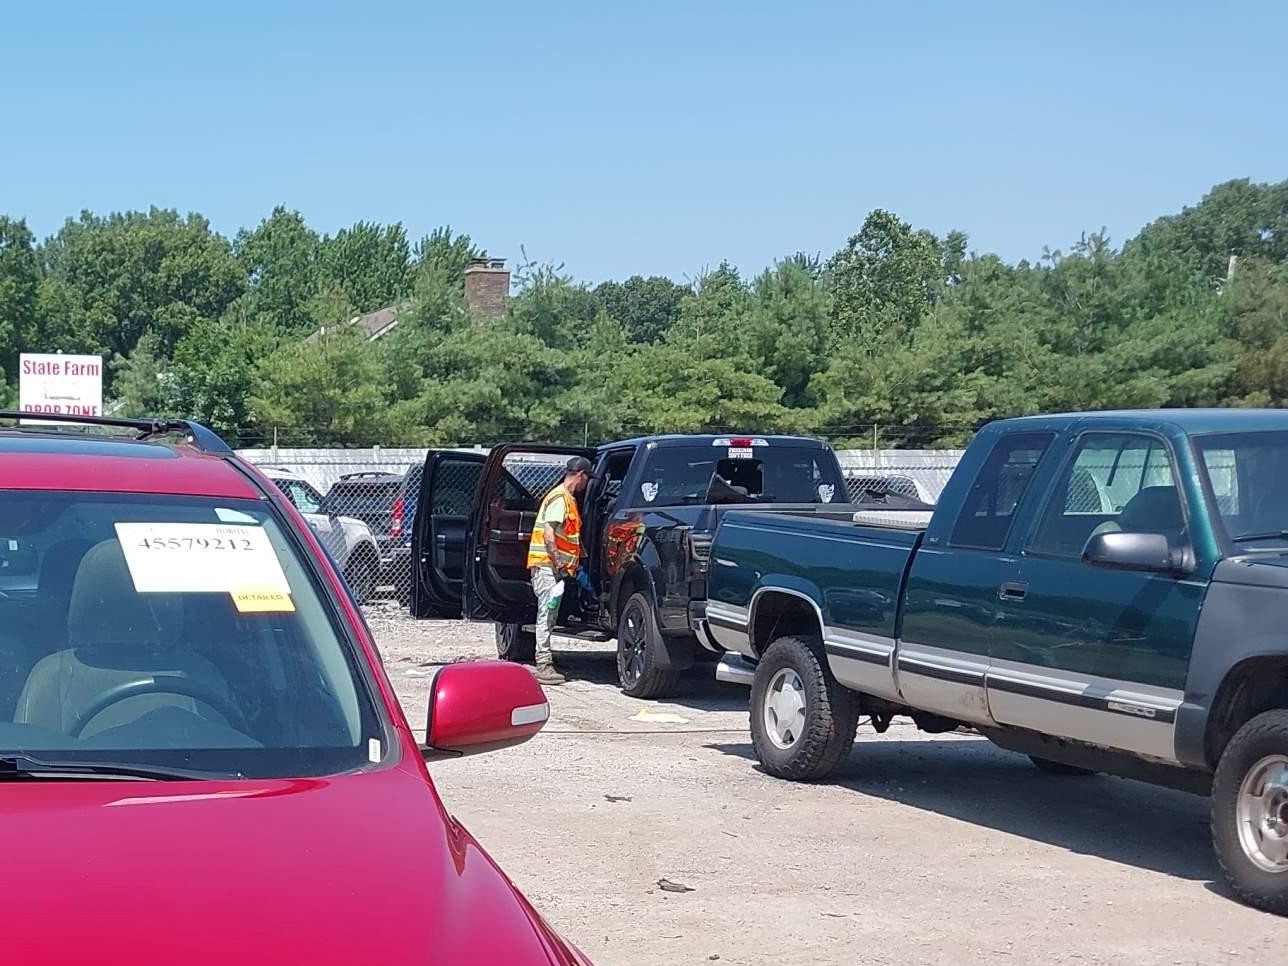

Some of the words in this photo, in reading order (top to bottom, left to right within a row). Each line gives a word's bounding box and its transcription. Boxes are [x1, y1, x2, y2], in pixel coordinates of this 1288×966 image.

[23, 359, 60, 376] State
[64, 360, 100, 377] Farm
[138, 537, 254, 551] 45579212
